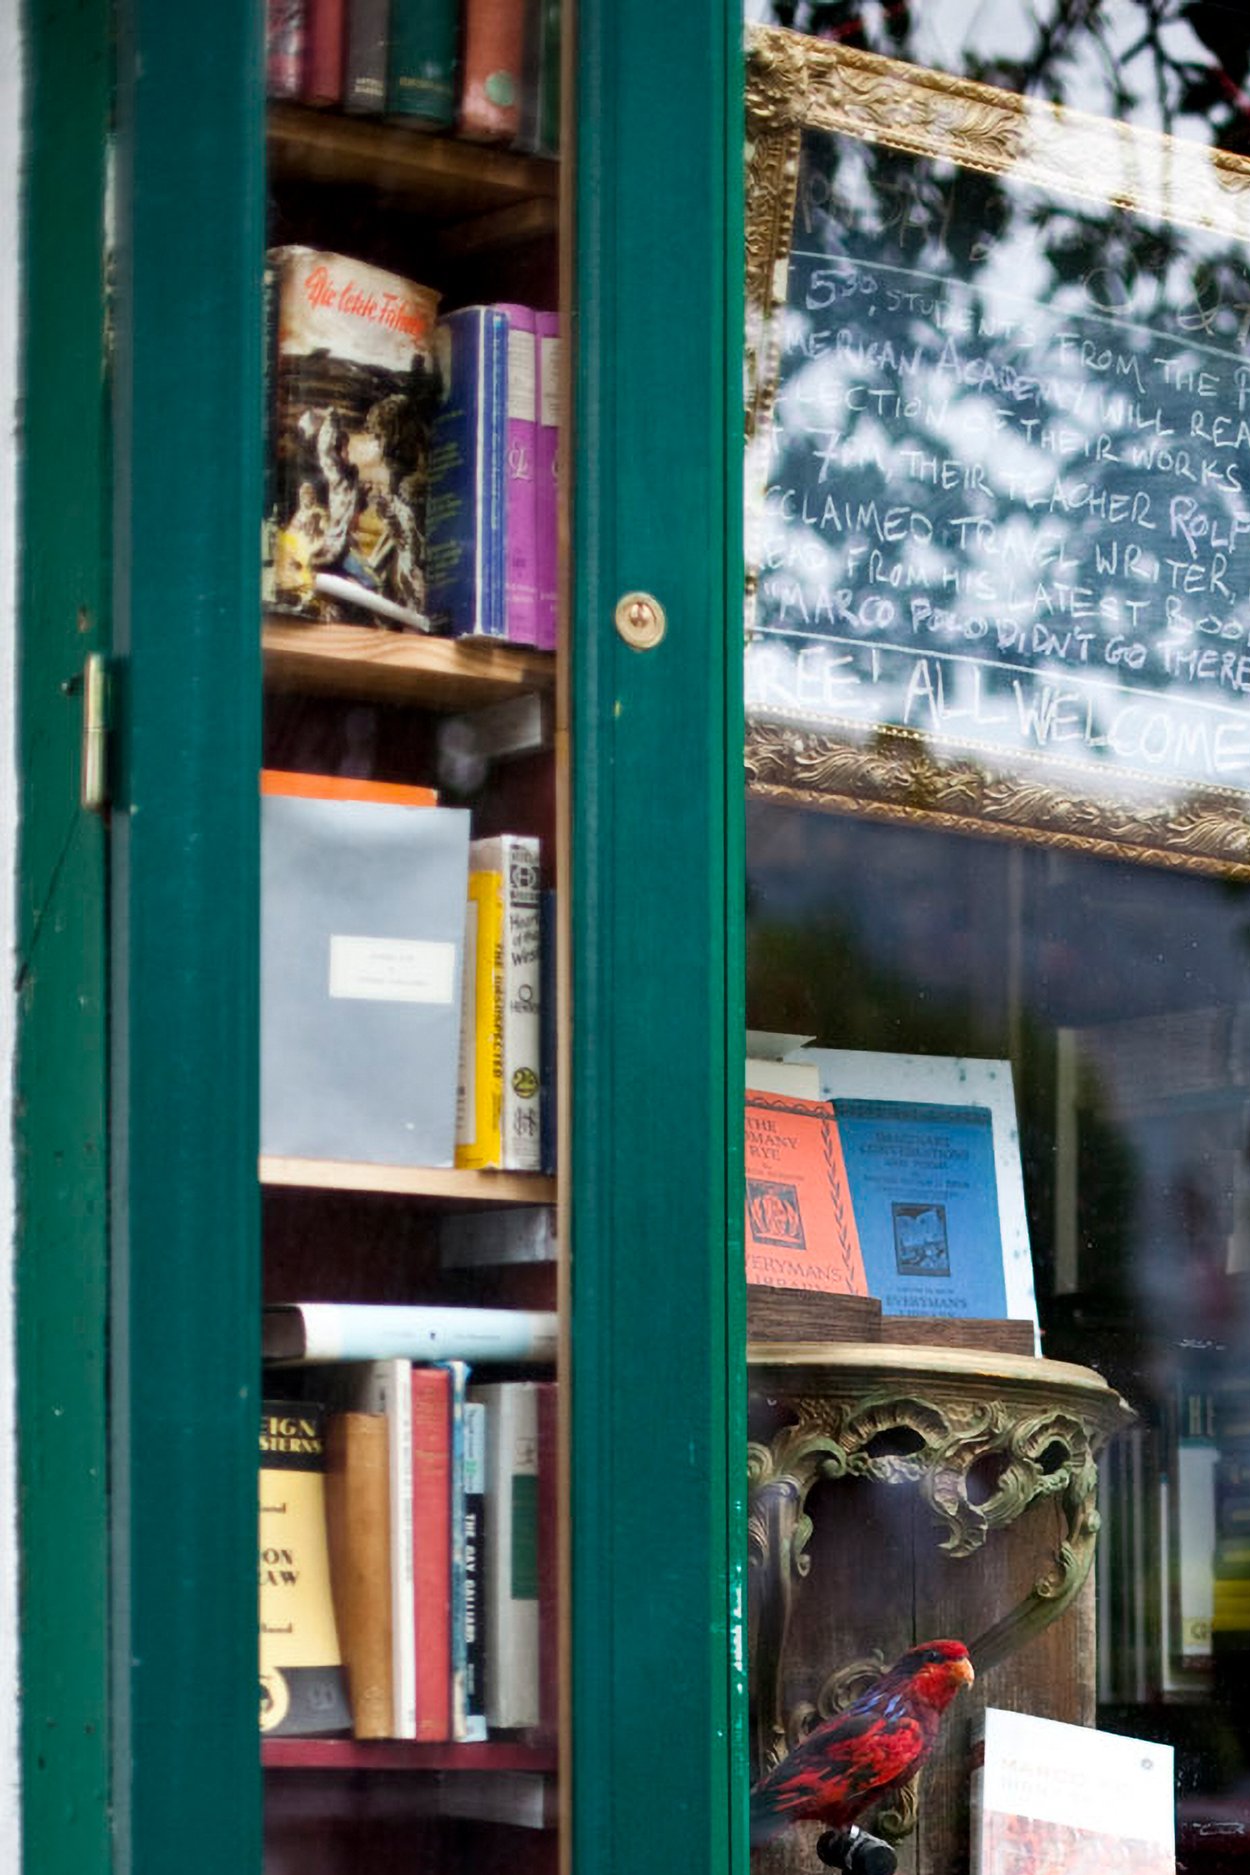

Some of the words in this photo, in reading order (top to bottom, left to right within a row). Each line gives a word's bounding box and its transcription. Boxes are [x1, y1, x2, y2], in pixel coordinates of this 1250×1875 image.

[1055, 332, 1146, 394] FROM
[1153, 357, 1220, 398] THE
[1101, 394, 1174, 438] WILL
[1020, 417, 1120, 462] THEIR
[1132, 445, 1242, 493] WORKS
[900, 450, 994, 498] THEIR
[1001, 470, 1156, 530] TEACHER
[950, 513, 1081, 570] TRAVEL
[847, 546, 929, 588] FROM
[943, 565, 997, 601] HIS
[1010, 576, 1150, 626] LATEST
[910, 597, 988, 639] POLO
[997, 615, 1097, 661] DIDN'T
[1104, 633, 1148, 670] GO
[903, 658, 1008, 730] ALL
[750, 1145, 781, 1161] RYE
[464, 1513, 477, 1538] THE
